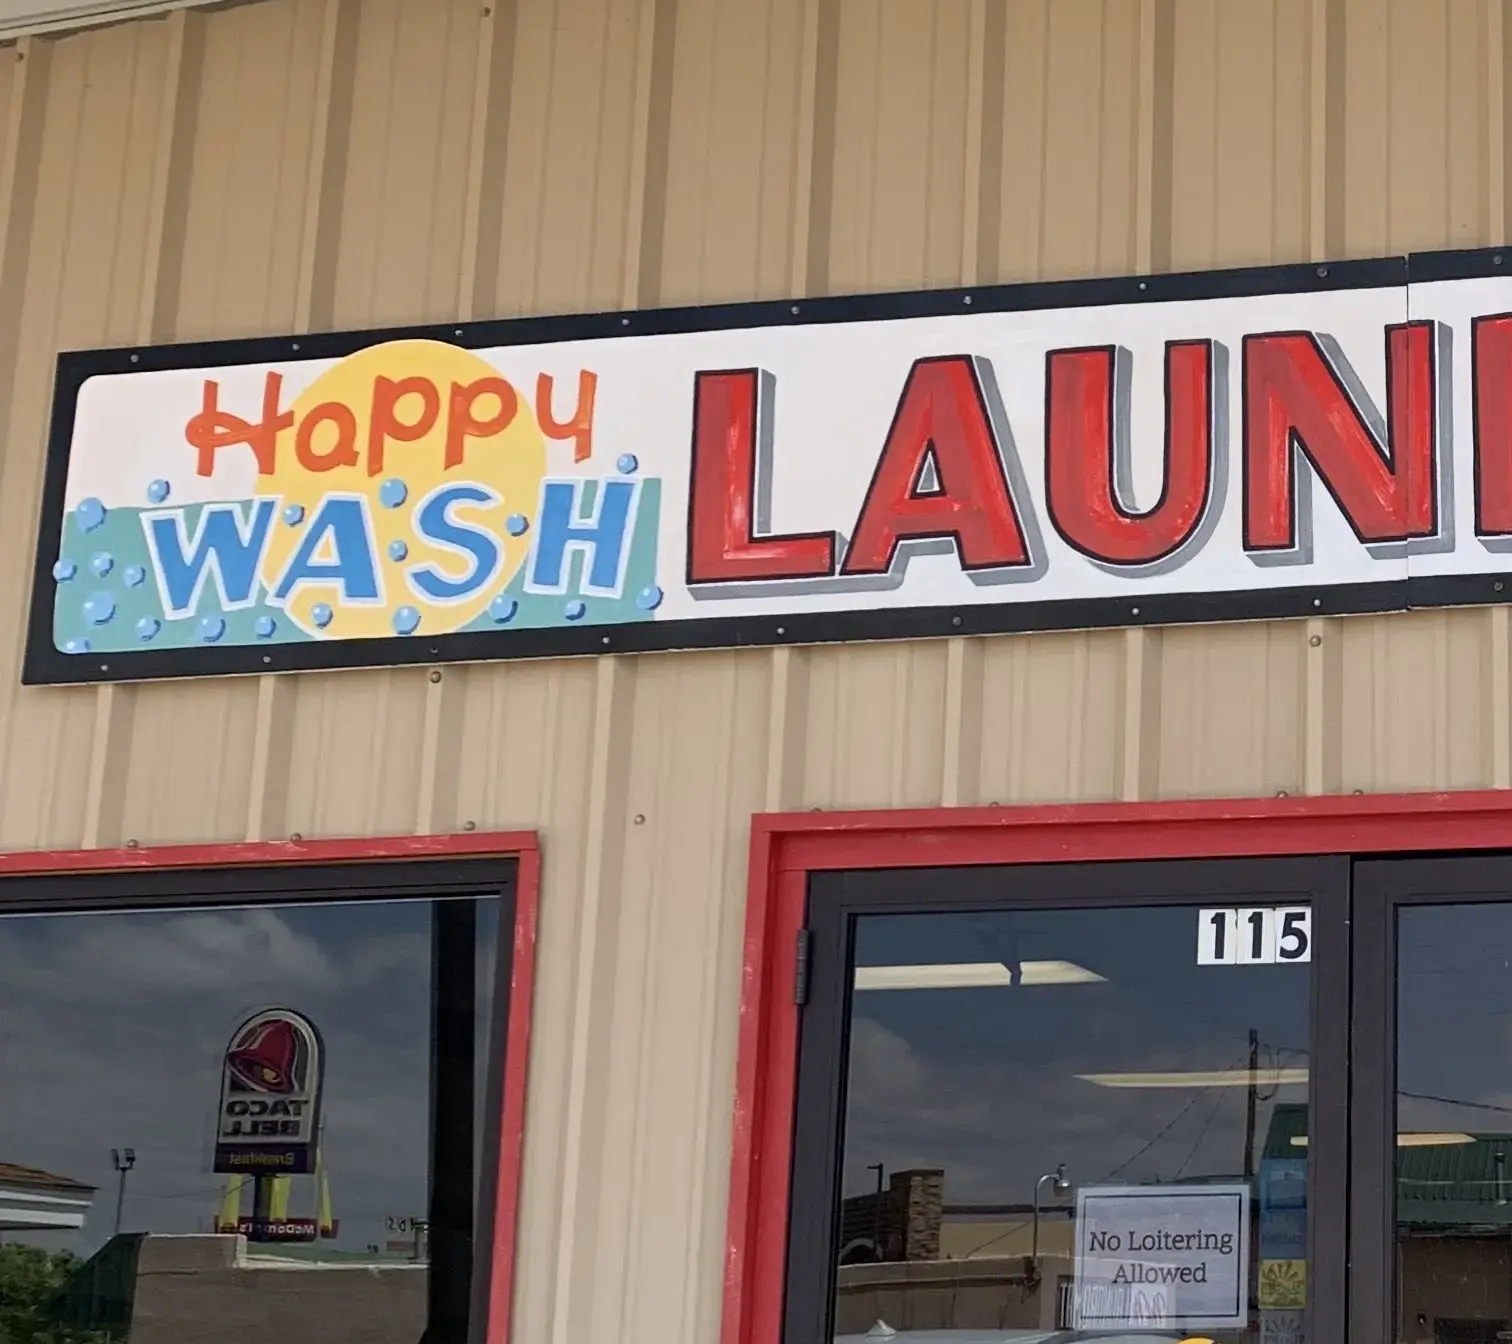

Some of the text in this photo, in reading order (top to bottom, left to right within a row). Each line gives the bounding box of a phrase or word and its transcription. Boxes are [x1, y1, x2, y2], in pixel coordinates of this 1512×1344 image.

[184, 368, 598, 478] Happy
[138, 475, 646, 622] WASH
[1210, 909, 1308, 961] 115
[1089, 1230, 1122, 1252] No
[1127, 1228, 1234, 1255] Loitering
[1111, 1262, 1208, 1285] Allowed
